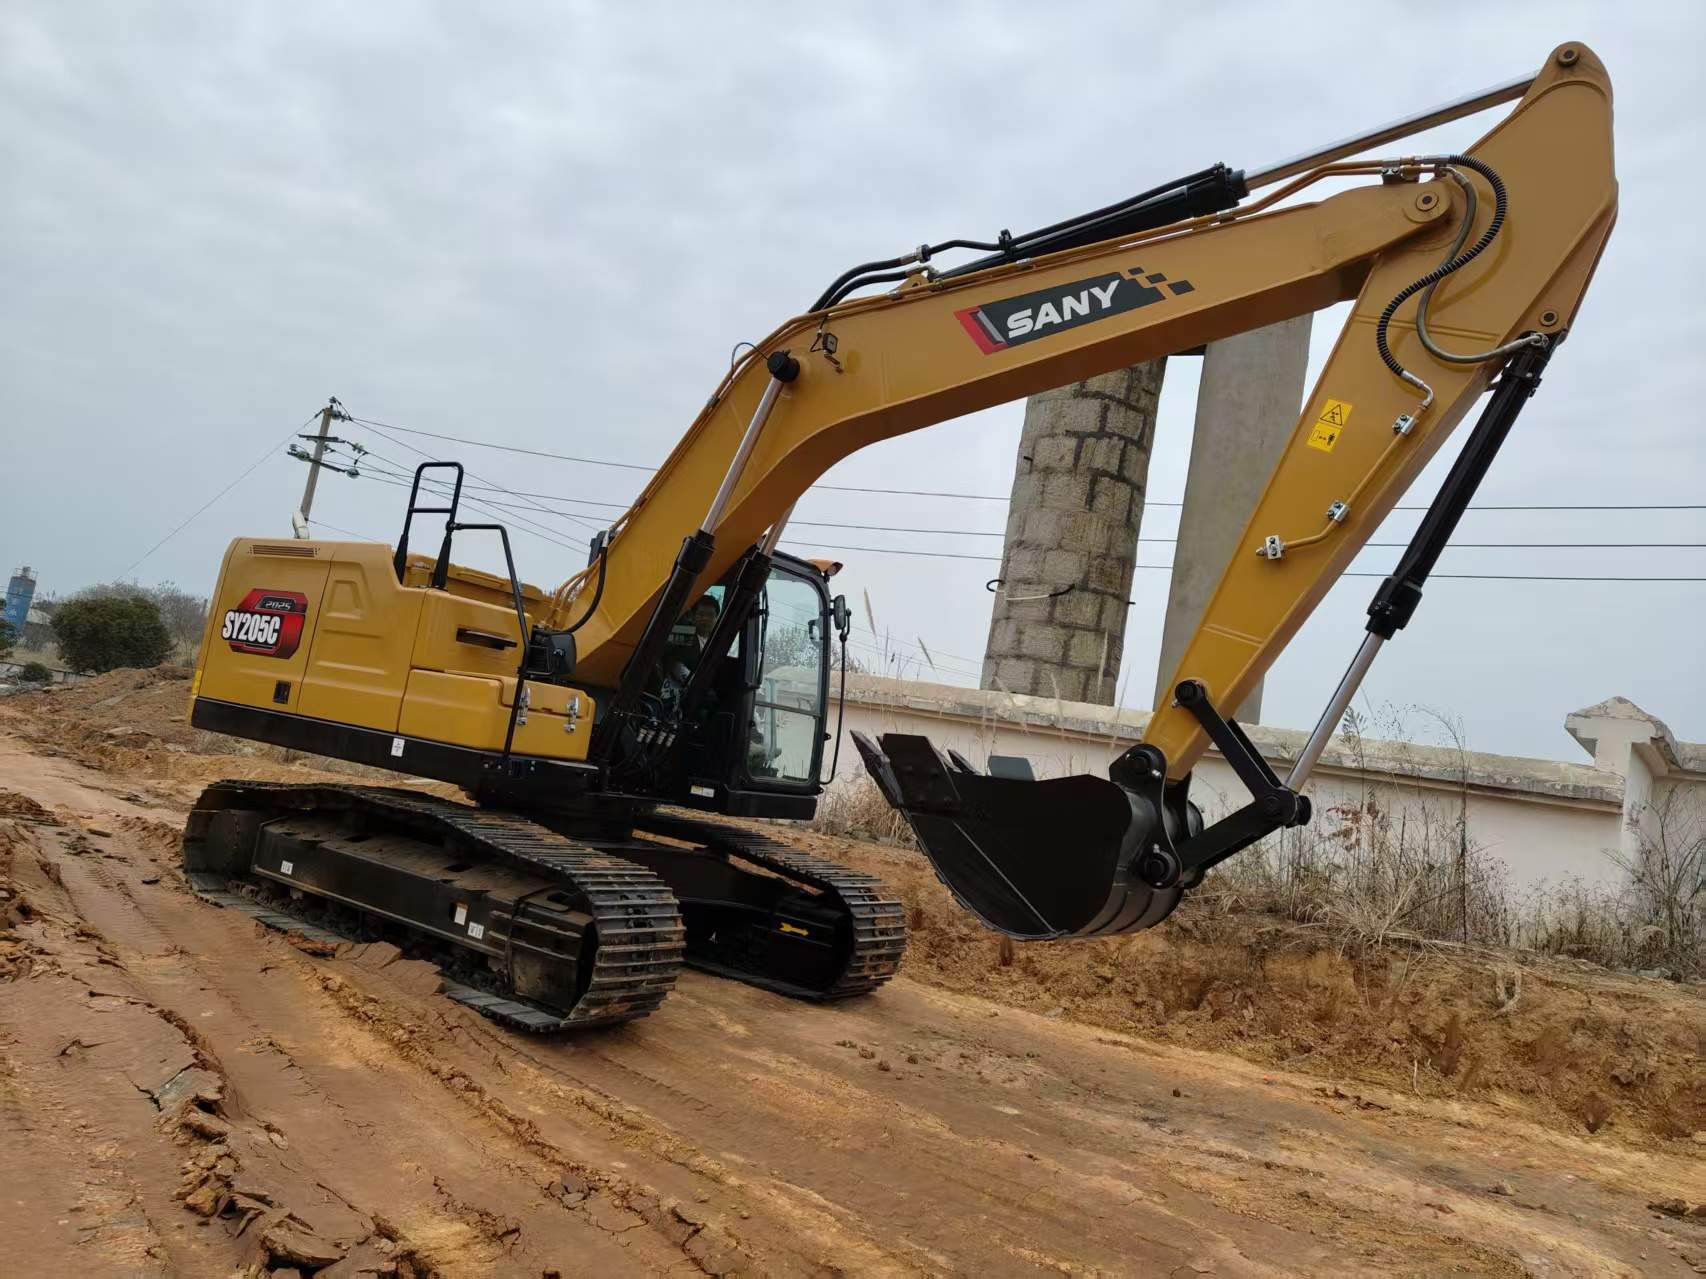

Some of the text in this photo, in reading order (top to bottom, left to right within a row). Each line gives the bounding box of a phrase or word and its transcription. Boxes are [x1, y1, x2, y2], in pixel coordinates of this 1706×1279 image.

[1006, 279, 1120, 339] SANY
[265, 600, 291, 610] 2025
[222, 610, 281, 645] SY205C
